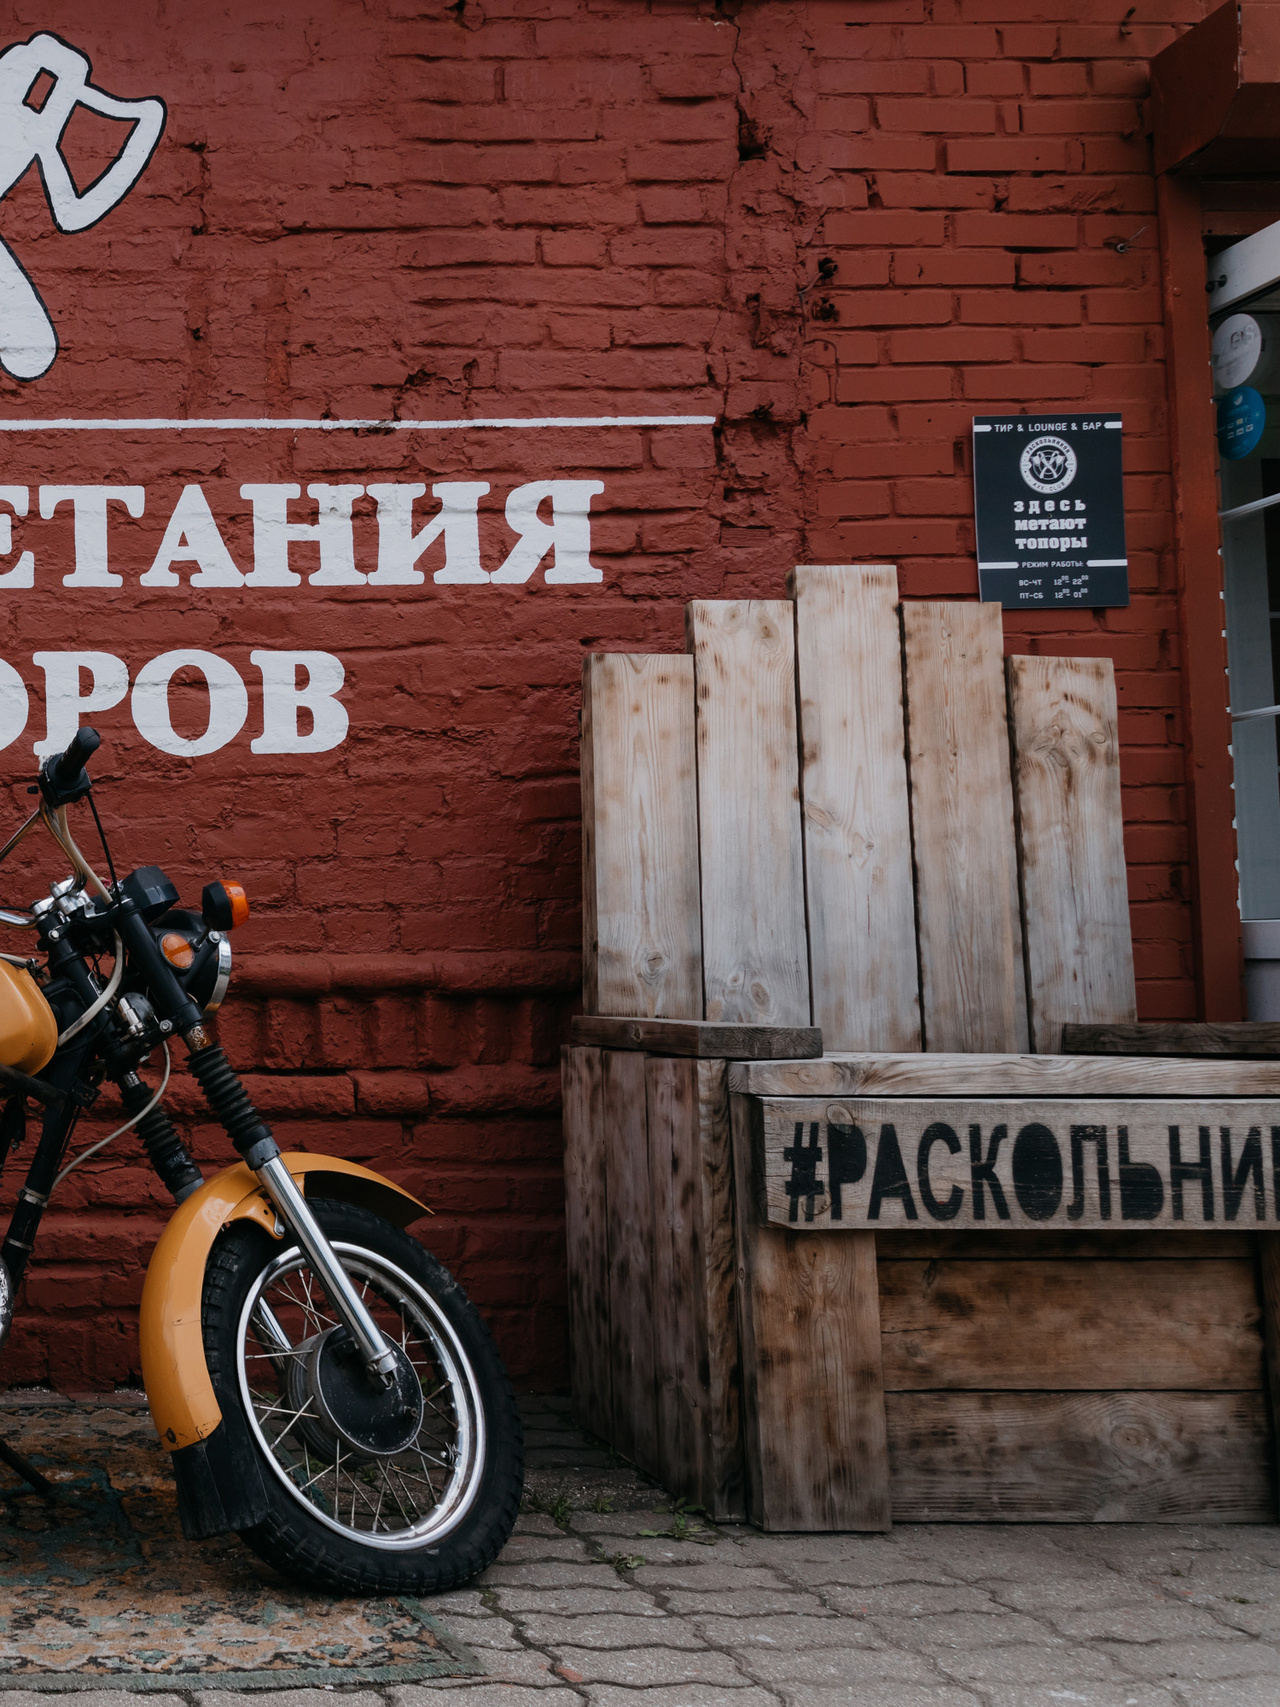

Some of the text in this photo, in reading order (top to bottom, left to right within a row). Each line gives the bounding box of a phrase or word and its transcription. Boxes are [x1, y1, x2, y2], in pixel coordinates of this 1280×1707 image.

[994, 421, 1102, 433] ТИР & LOUNGE & БАР
[1021, 561, 1049, 569] РЕЖИМ
[1018, 579, 1042, 587] ВС-ЧТ
[1019, 592, 1044, 600] ПТ-СБ
[784, 1122, 1280, 1222] #РАСКОЛЬНИ
